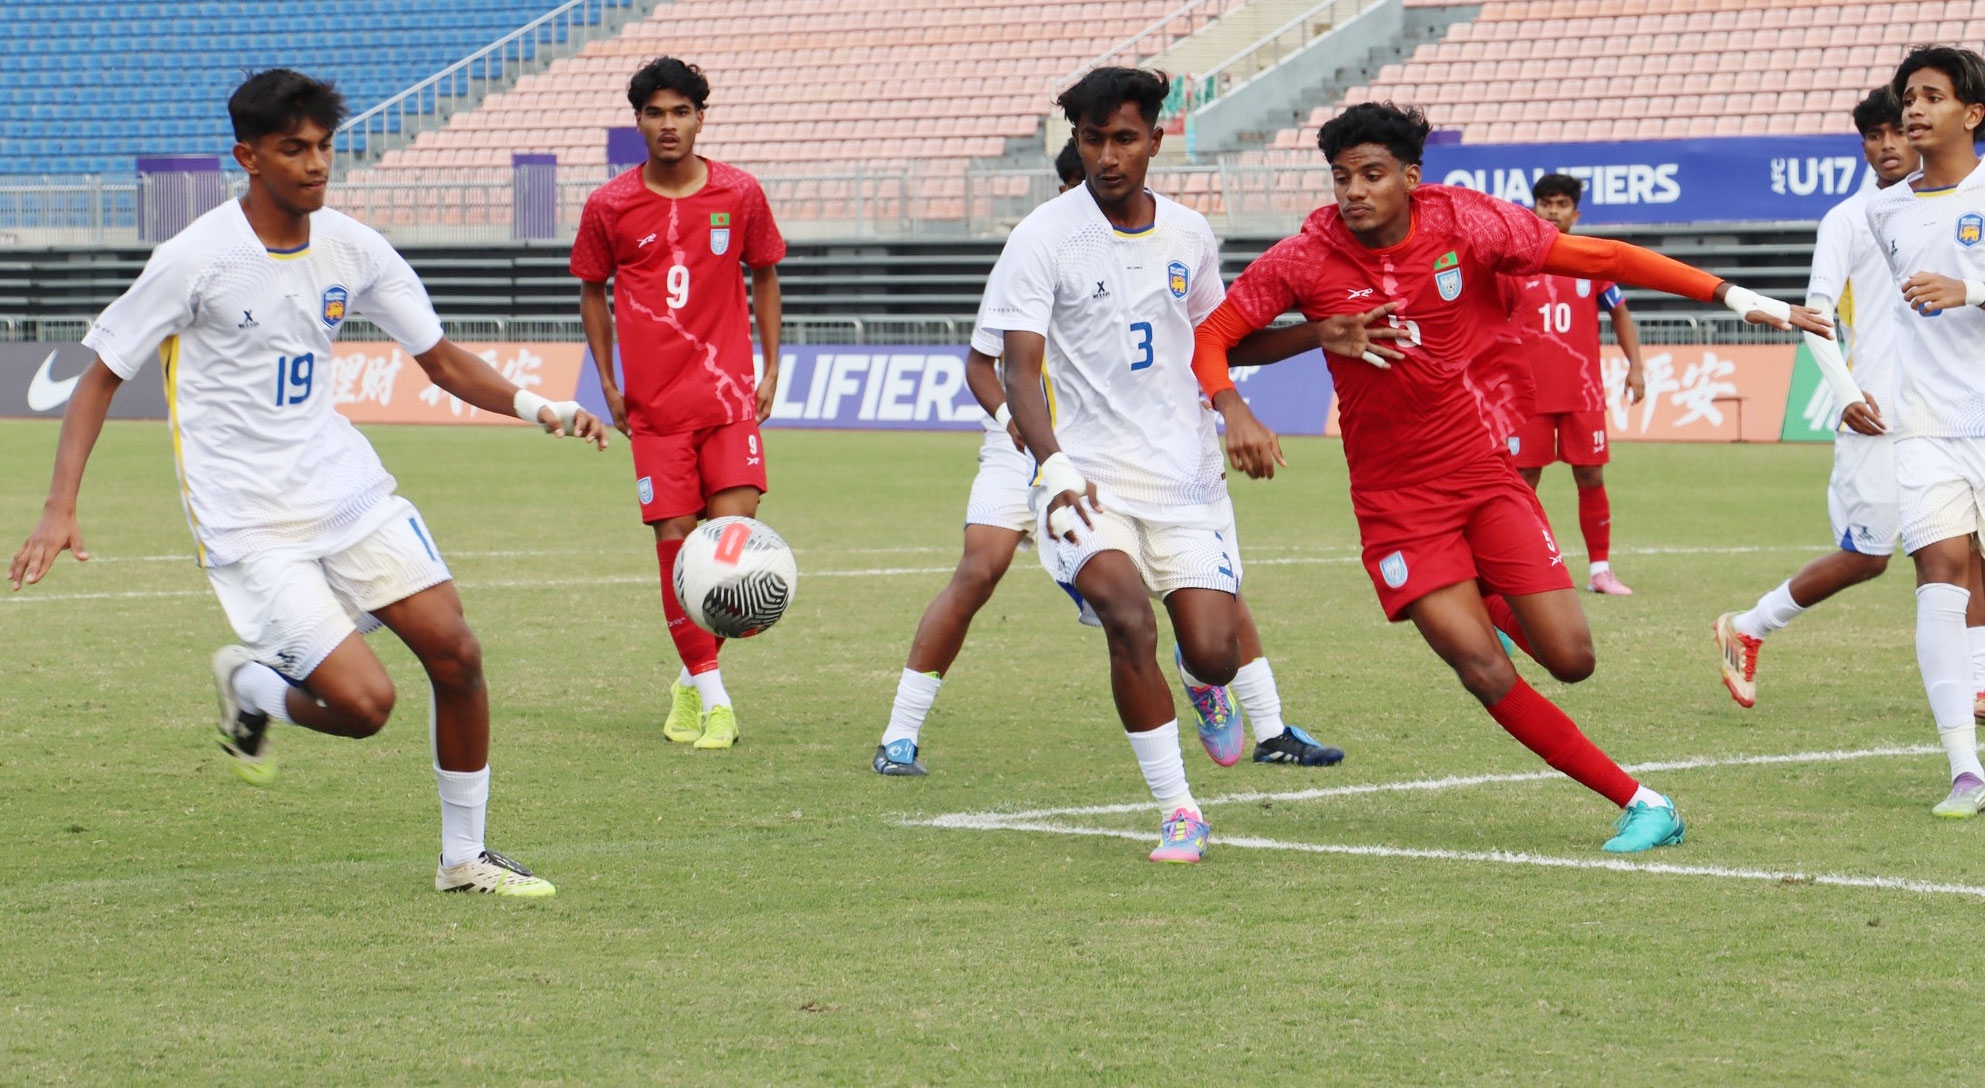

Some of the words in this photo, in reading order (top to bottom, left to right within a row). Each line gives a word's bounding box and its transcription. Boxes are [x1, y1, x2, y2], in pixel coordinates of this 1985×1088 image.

[1770, 157, 1786, 195] AFC
[1787, 156, 1857, 196] U17
[666, 265, 690, 309] 9
[1538, 302, 1572, 333] 10
[1130, 321, 1154, 371] 3
[276, 352, 314, 406] 19
[747, 435, 758, 455] 9
[1593, 430, 1605, 445] 10
